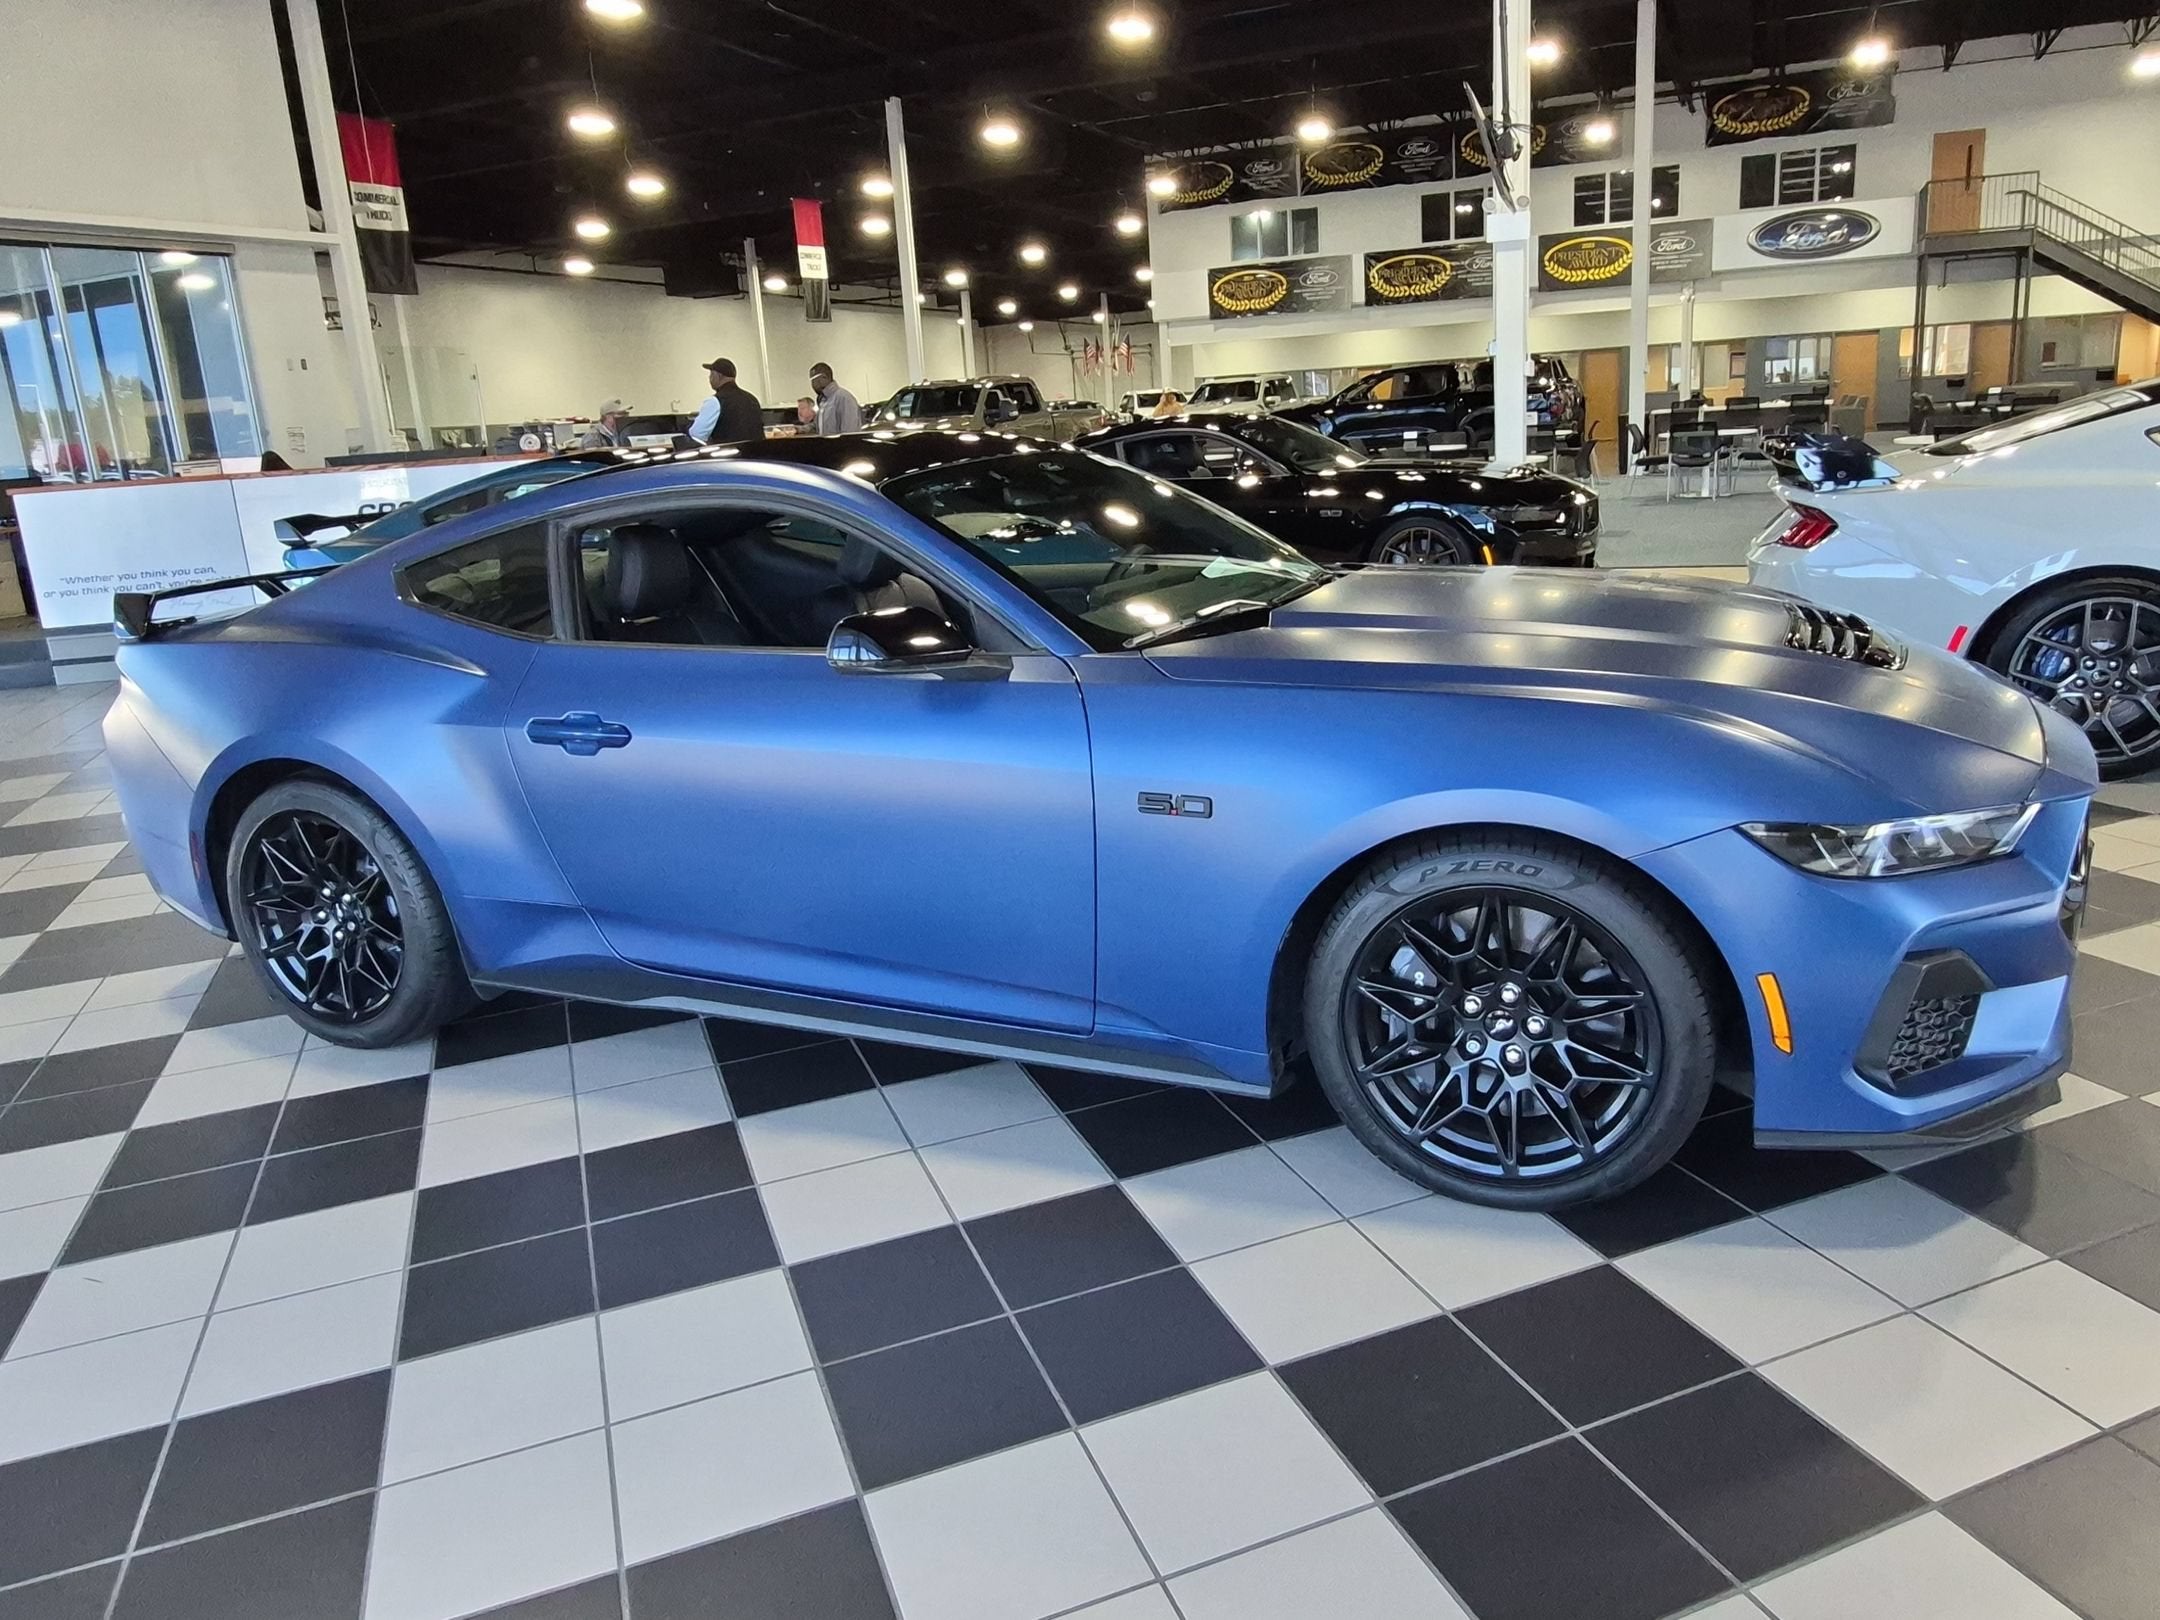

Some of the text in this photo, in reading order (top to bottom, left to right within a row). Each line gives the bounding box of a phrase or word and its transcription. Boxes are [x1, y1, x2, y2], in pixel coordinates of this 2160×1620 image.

[1780, 220, 1849, 250] Ford
[1657, 238, 1687, 251] Ford
[1306, 272, 1331, 284] Ford
[117, 572, 137, 581] you
[140, 568, 169, 579] think
[171, 566, 191, 577] you
[194, 565, 216, 574] can,
[43, 590, 56, 599] or
[59, 588, 79, 599] you
[82, 585, 110, 595] think
[113, 583, 133, 593] you
[1137, 791, 1213, 819] 5.0
[1418, 859, 1544, 883] P ZERO
